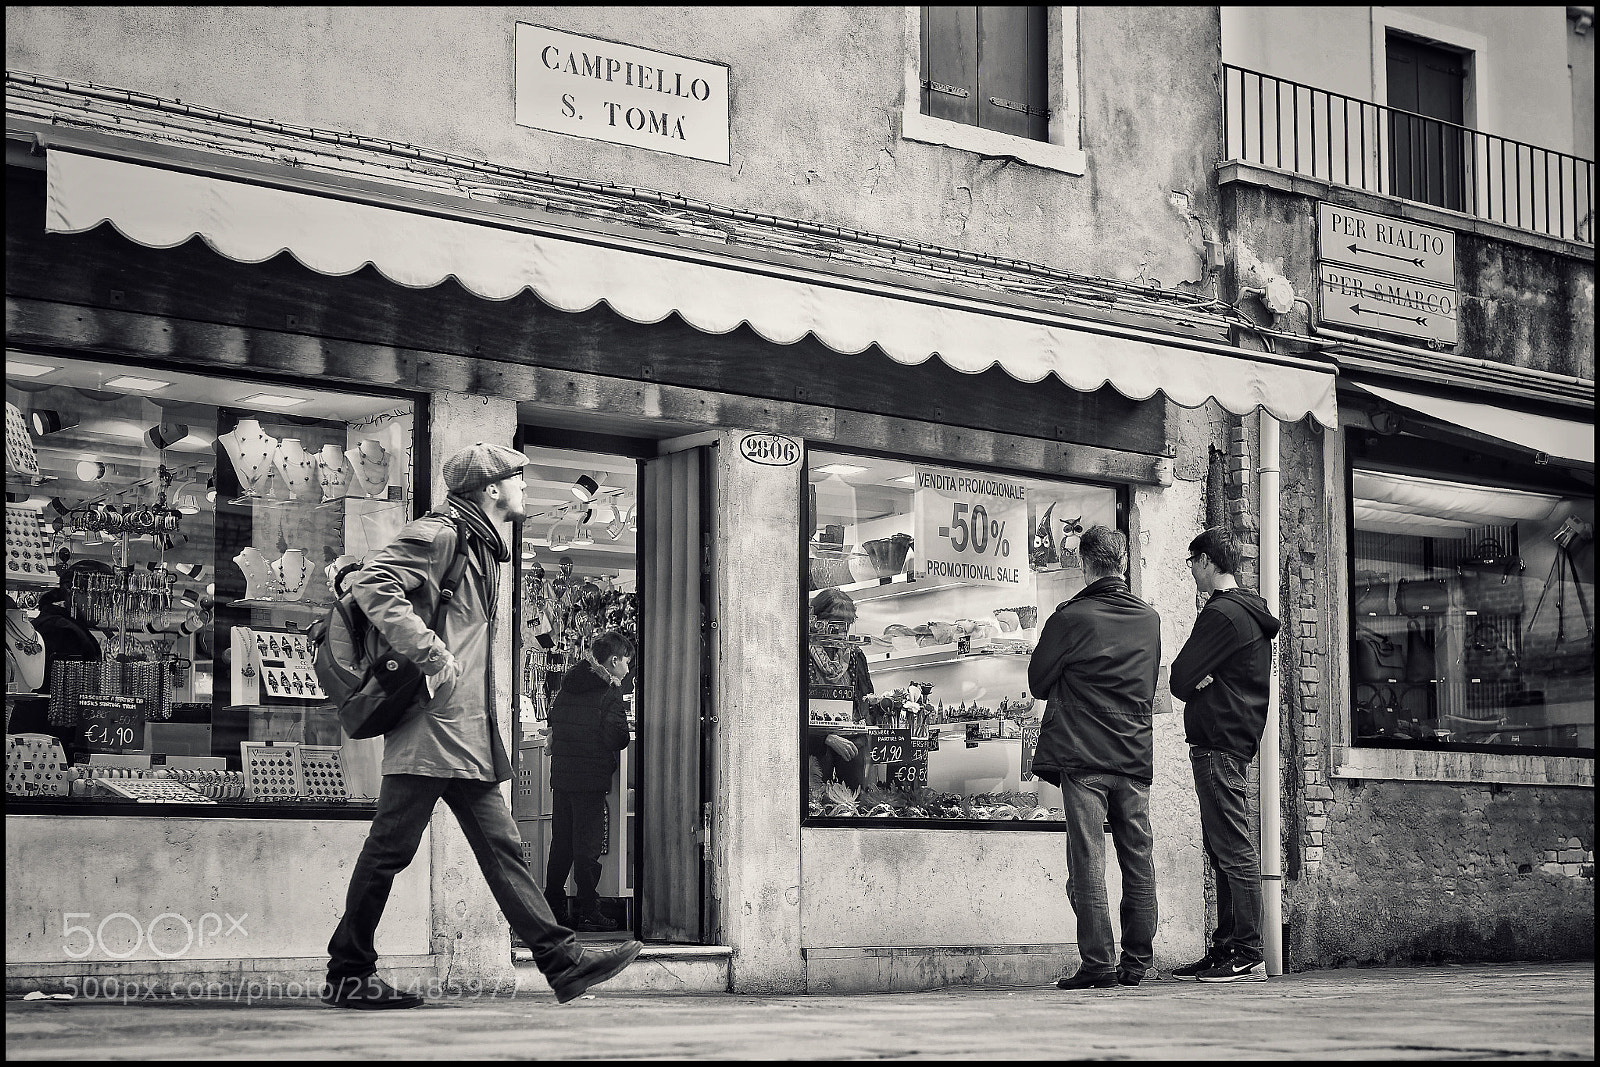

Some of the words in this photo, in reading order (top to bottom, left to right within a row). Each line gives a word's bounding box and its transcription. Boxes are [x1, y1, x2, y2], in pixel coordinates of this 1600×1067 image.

[541, 45, 710, 102] CAMPIELLO
[561, 93, 584, 120] S.
[1331, 212, 1367, 239] PER
[1376, 222, 1444, 256] RIALTO
[1328, 273, 1365, 299] PER
[746, 438, 795, 462] 2806
[918, 471, 957, 492] VENDITA
[958, 477, 1025, 501] PROMOZIONALE
[938, 502, 1010, 558] -50%
[927, 559, 995, 581] PROMOTIONAL
[997, 567, 1019, 584] SALE
[84, 724, 134, 746] €1,90
